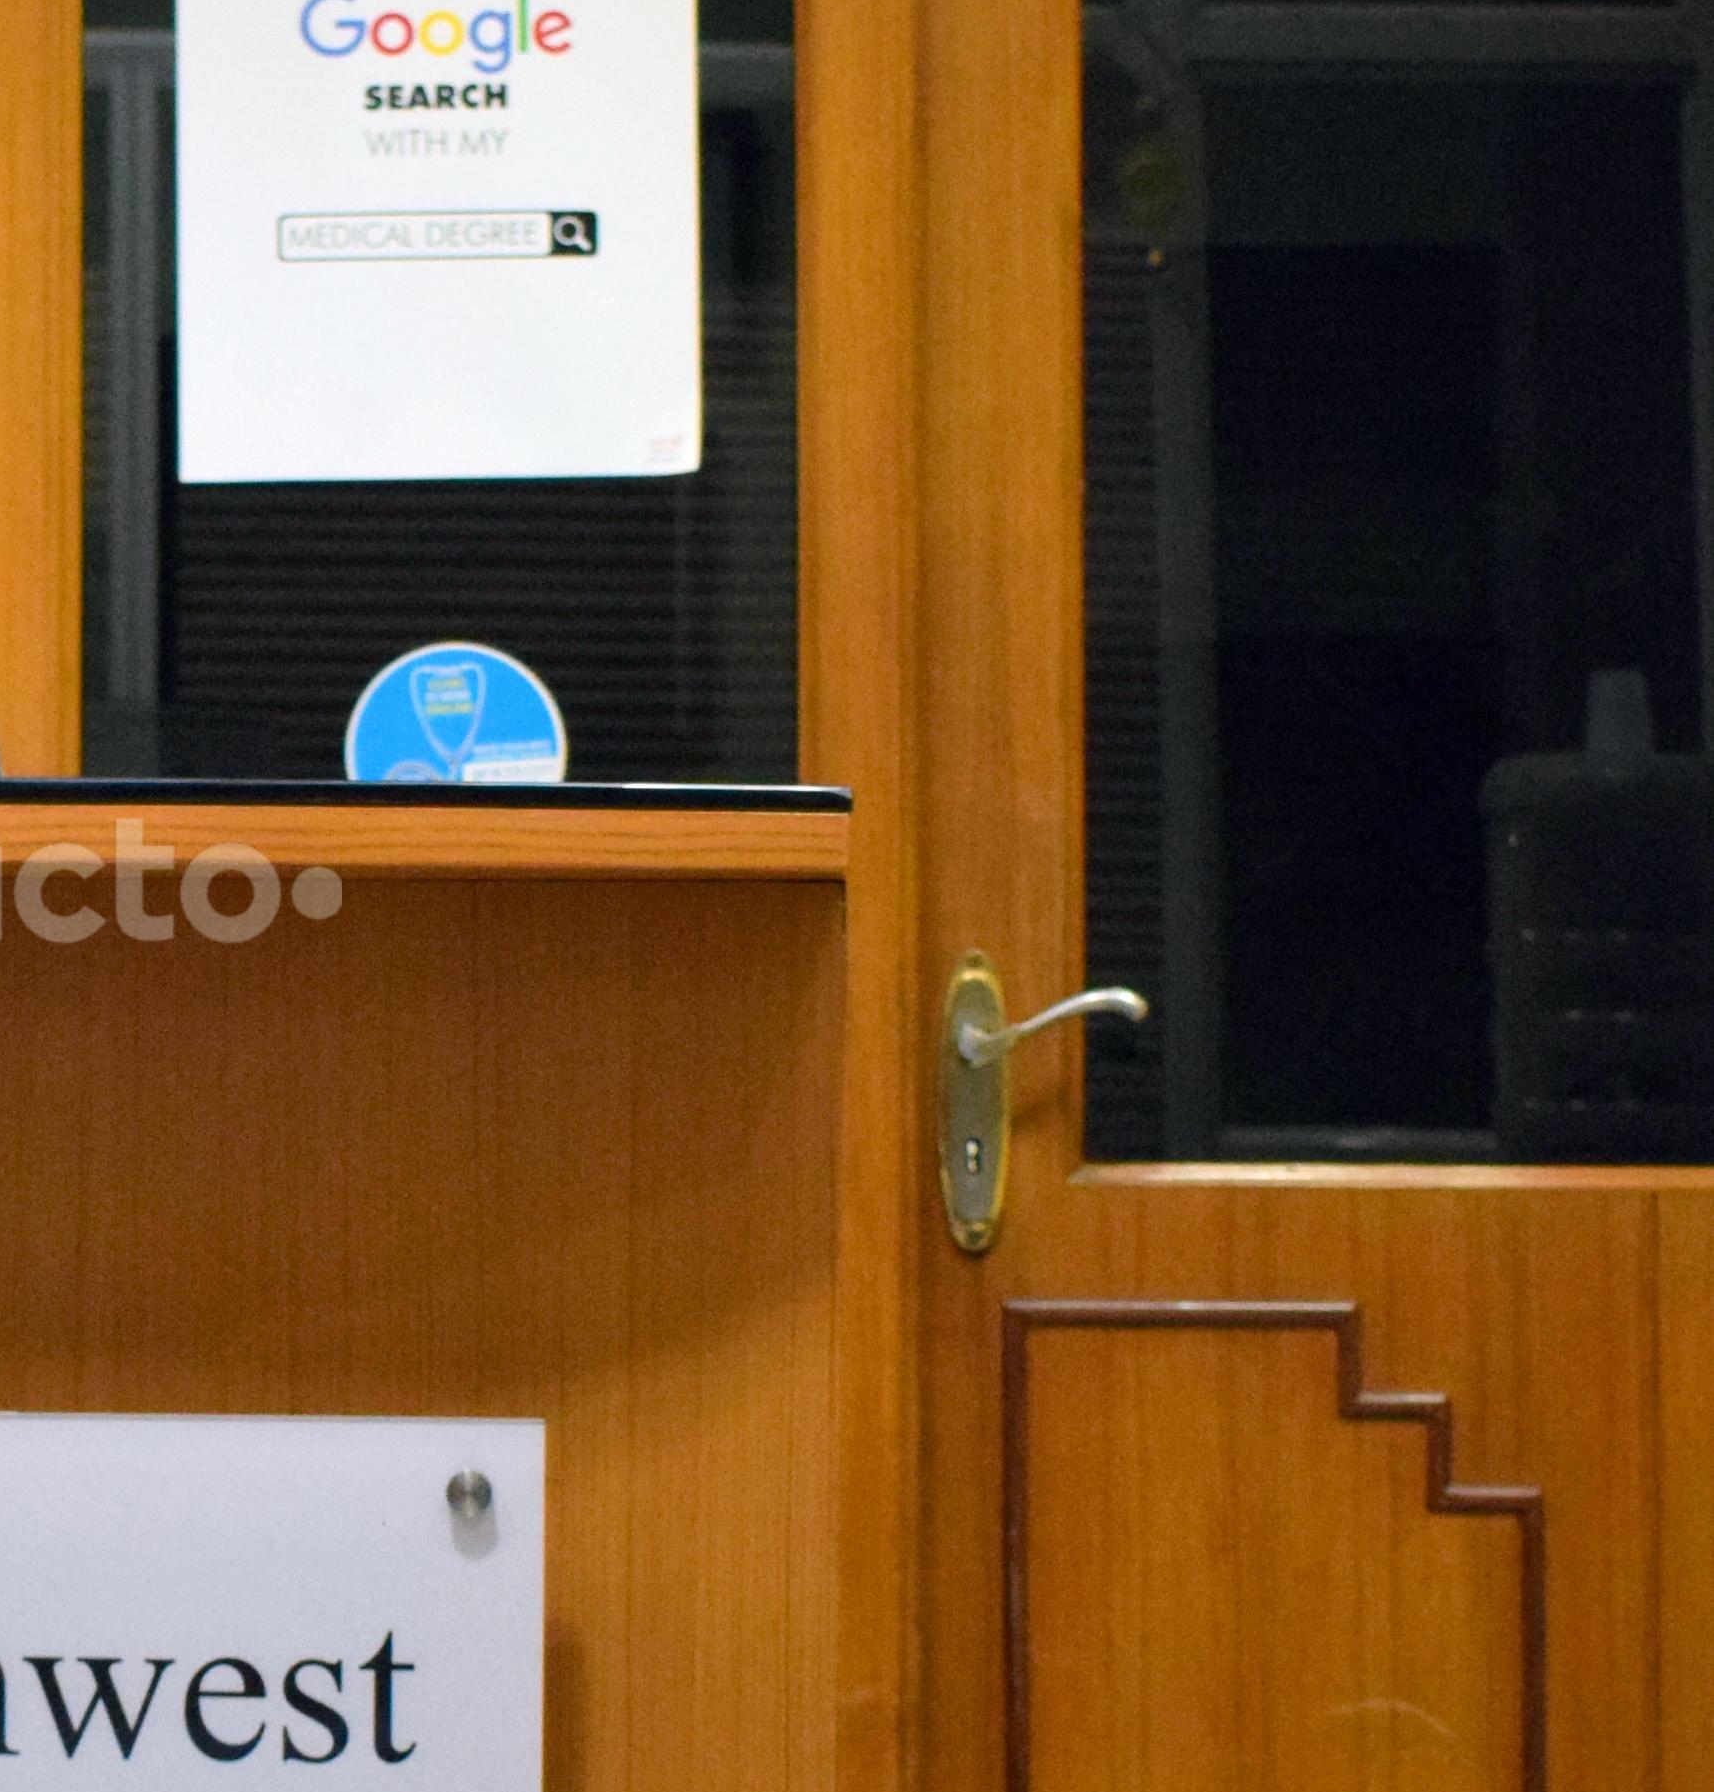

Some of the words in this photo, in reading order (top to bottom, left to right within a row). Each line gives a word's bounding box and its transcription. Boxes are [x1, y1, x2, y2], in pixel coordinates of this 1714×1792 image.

[363, 83, 509, 111] SEARCH
[363, 128, 448, 157] WITH
[457, 128, 509, 156] MY
[287, 221, 414, 250] MEDICAL
[424, 219, 538, 248] DEGREE
